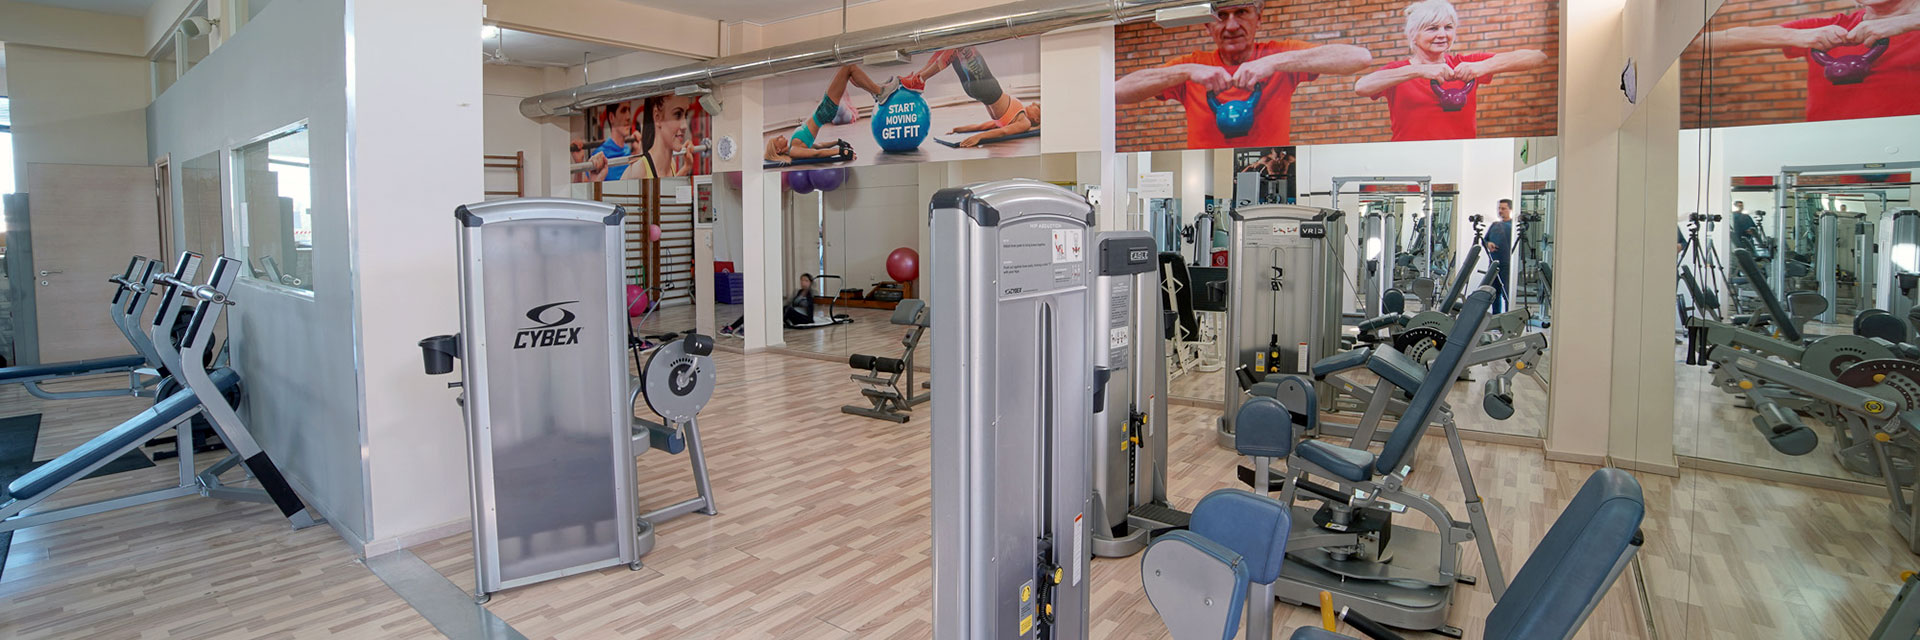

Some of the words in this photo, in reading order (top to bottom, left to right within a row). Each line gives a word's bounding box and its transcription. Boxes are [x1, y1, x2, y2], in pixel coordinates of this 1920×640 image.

[888, 102, 915, 114] START
[885, 113, 917, 126] MOVING
[882, 126, 902, 140] GET
[904, 125, 920, 138] FIT
[513, 327, 582, 350] CYBEX
